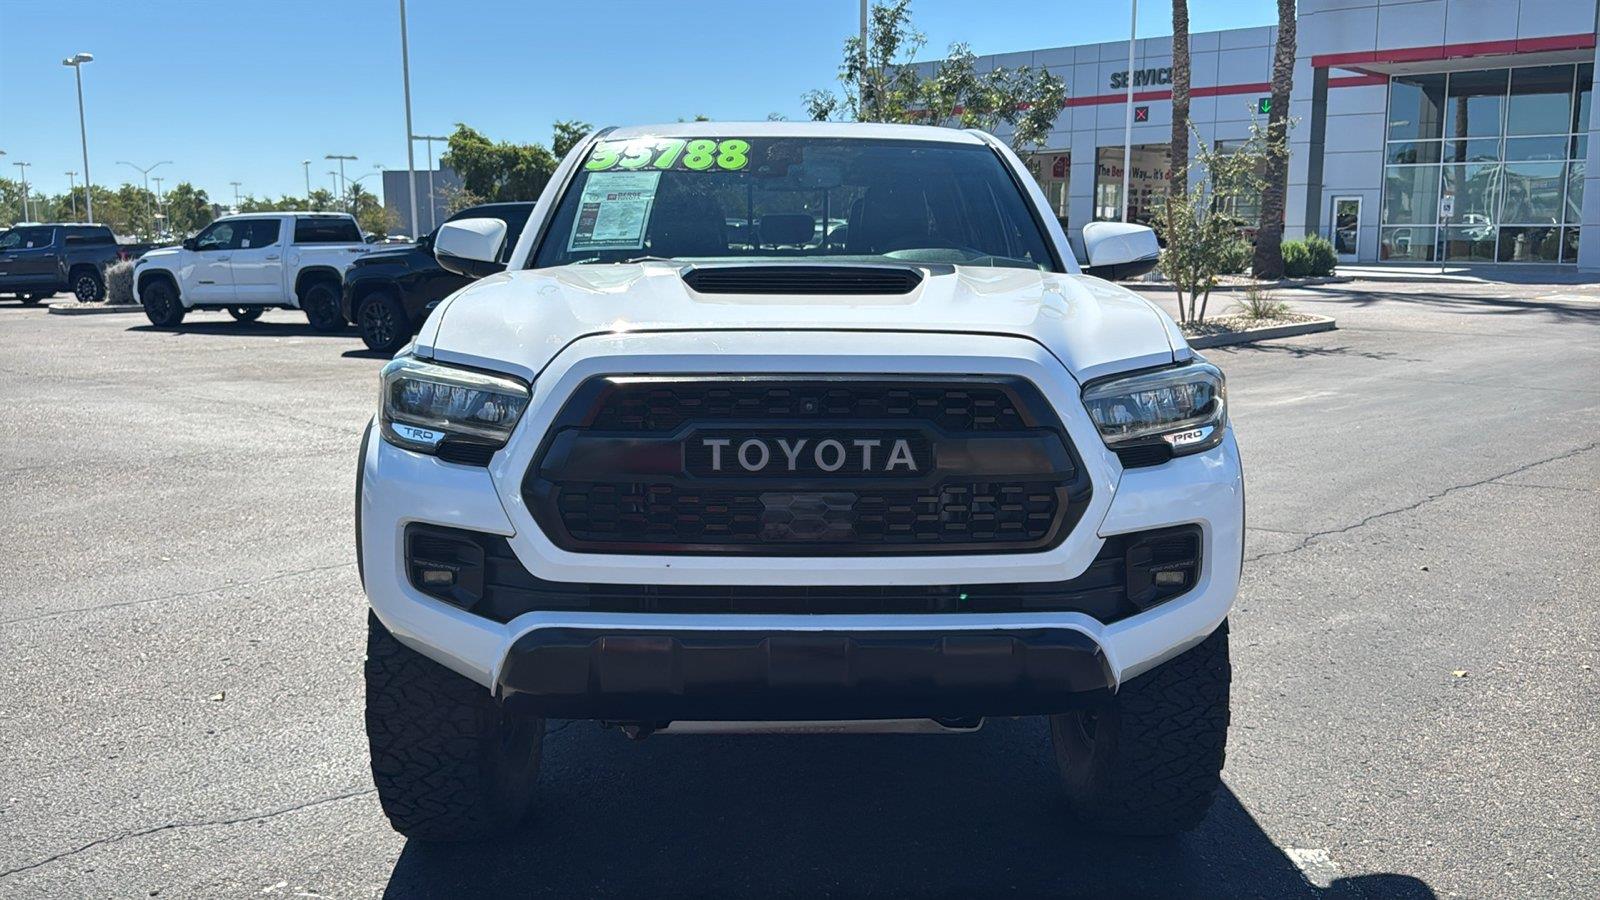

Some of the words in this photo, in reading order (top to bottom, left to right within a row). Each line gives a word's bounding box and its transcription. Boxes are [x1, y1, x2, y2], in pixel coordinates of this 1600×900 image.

[404, 427, 433, 440] TRD
[1174, 431, 1203, 442] PRO
[703, 439, 918, 472] TOYOTA
